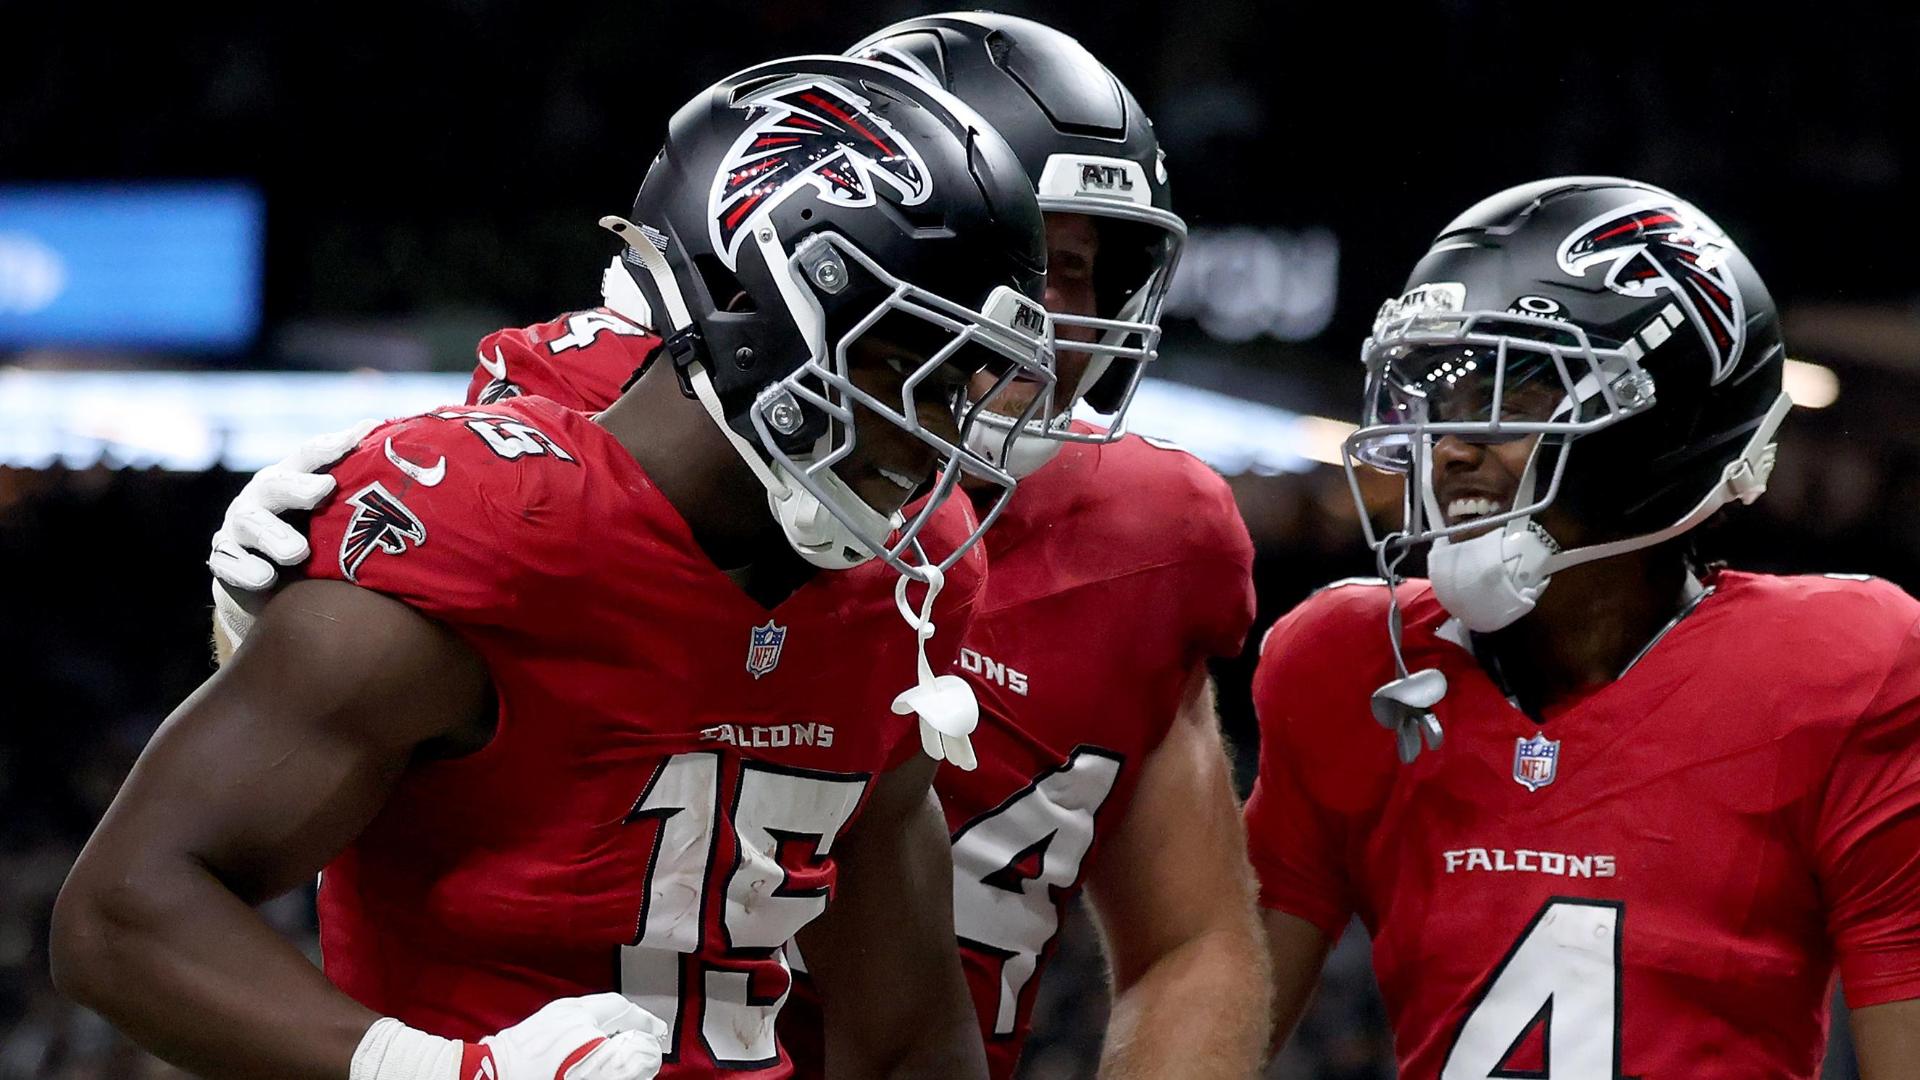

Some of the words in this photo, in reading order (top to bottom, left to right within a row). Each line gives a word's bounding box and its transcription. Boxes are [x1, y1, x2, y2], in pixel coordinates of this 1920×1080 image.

[1081, 164, 1133, 190] ATL
[548, 311, 646, 354] 4
[1013, 302, 1045, 336] ATL
[752, 646, 778, 668] NFL
[953, 647, 1029, 697] ONS
[700, 722, 834, 747] FALCONS
[1520, 759, 1549, 780] NFL
[1443, 847, 1616, 878] FALCONS
[616, 751, 872, 1066] 15
[950, 745, 1126, 1041] 4
[1438, 896, 1623, 1080] 4
